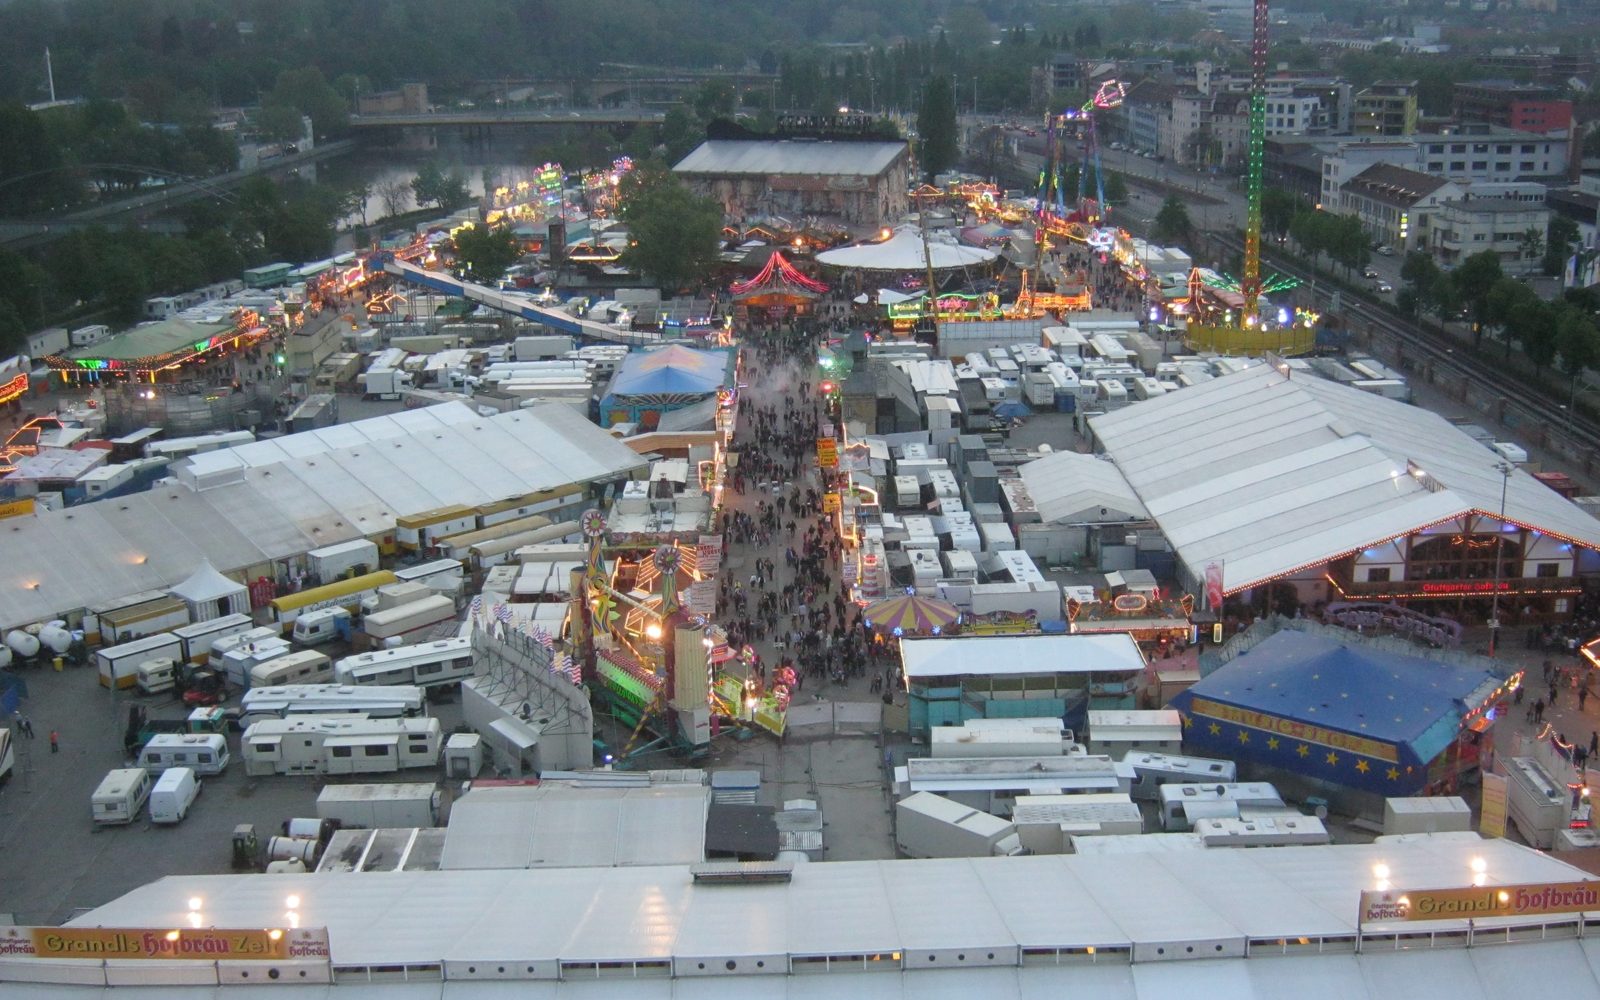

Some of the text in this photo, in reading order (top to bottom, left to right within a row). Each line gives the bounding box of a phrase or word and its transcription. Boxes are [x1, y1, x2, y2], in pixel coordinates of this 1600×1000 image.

[1515, 887, 1597, 912] Hofbräu
[44, 933, 140, 952] Grandls
[143, 932, 229, 956] Hofbräu
